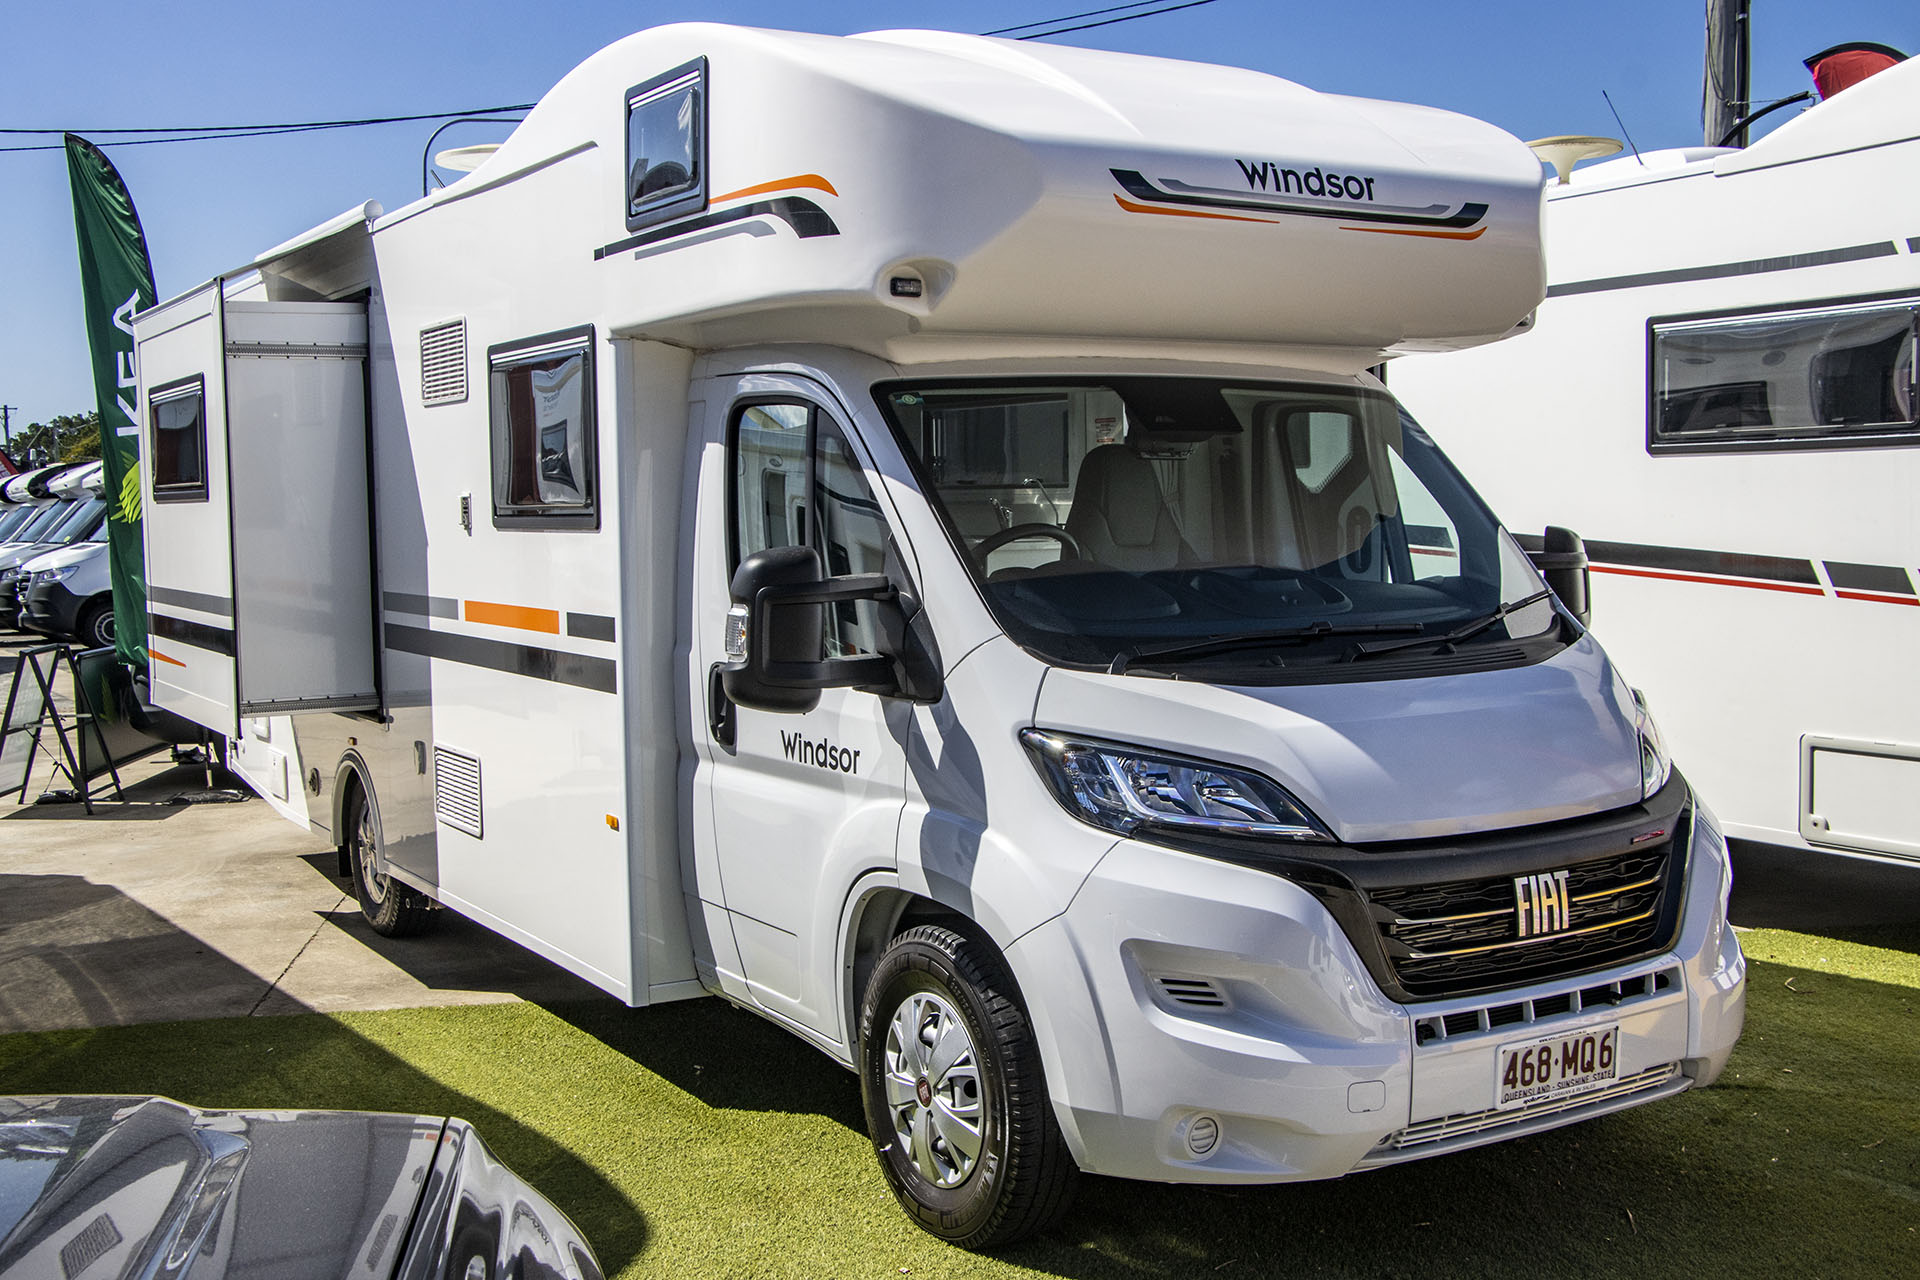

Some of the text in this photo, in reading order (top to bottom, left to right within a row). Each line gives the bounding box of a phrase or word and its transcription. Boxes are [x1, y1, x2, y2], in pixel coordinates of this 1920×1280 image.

[1235, 158, 1375, 201] Windsor
[780, 729, 861, 775] Windsor
[1514, 870, 1569, 938] FIAT
[1503, 1084, 1551, 1101] QUEENSLAND
[1556, 1075, 1590, 1089] SUNSHINE
[1592, 1069, 1612, 1081] STATE
